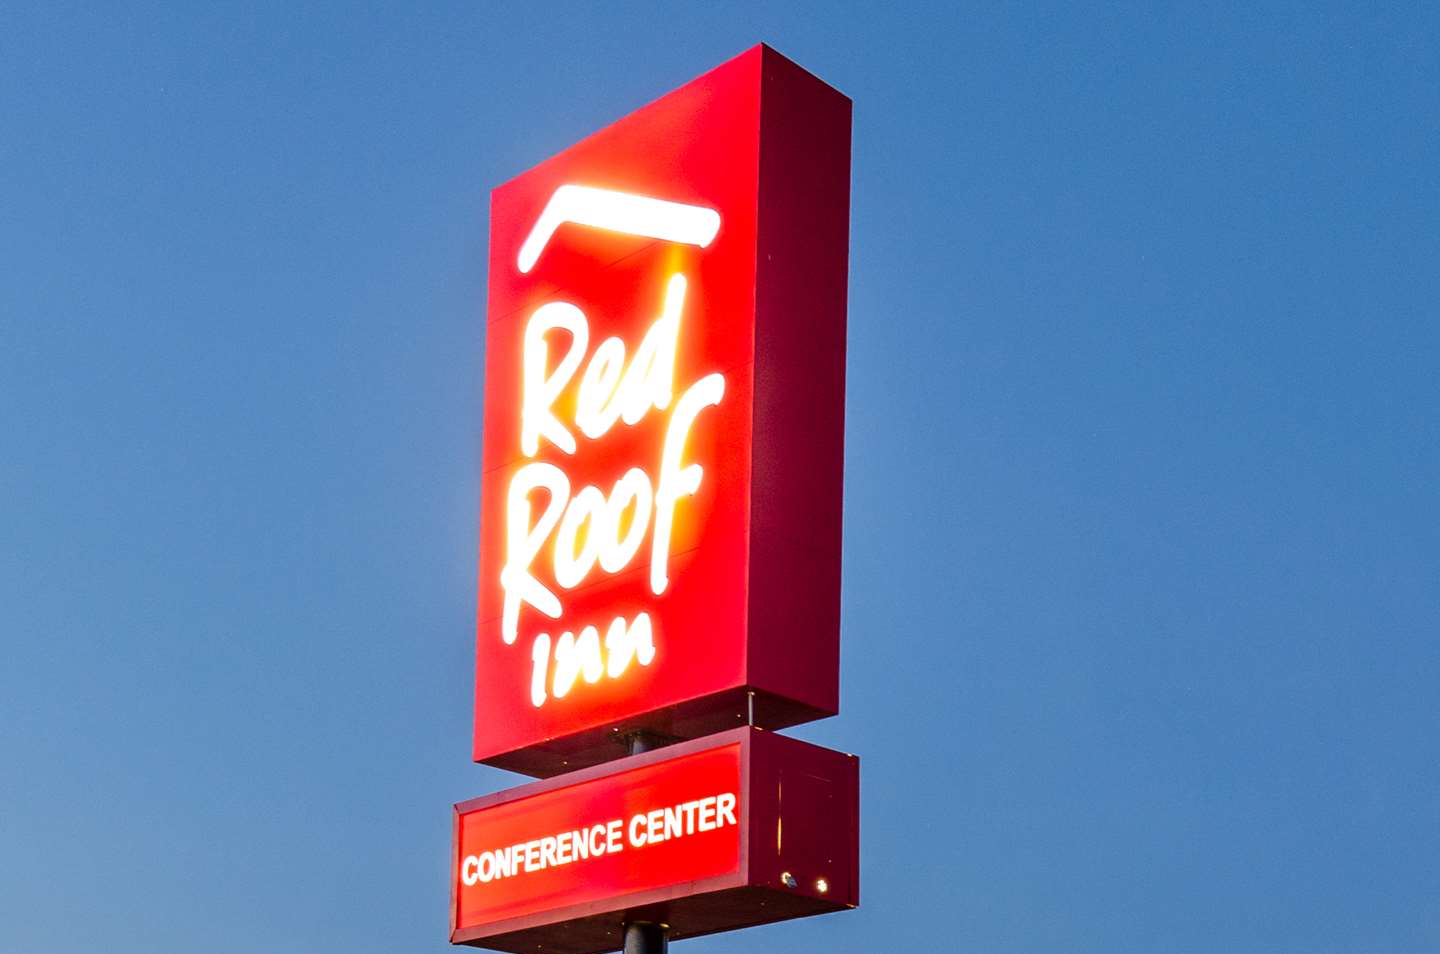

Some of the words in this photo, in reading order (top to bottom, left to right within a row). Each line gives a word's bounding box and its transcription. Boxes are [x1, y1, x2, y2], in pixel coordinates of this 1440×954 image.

[522, 273, 687, 457] Red
[501, 372, 725, 645] Roof
[462, 820, 623, 886] CONFERENCE
[629, 792, 737, 848] CENTER
